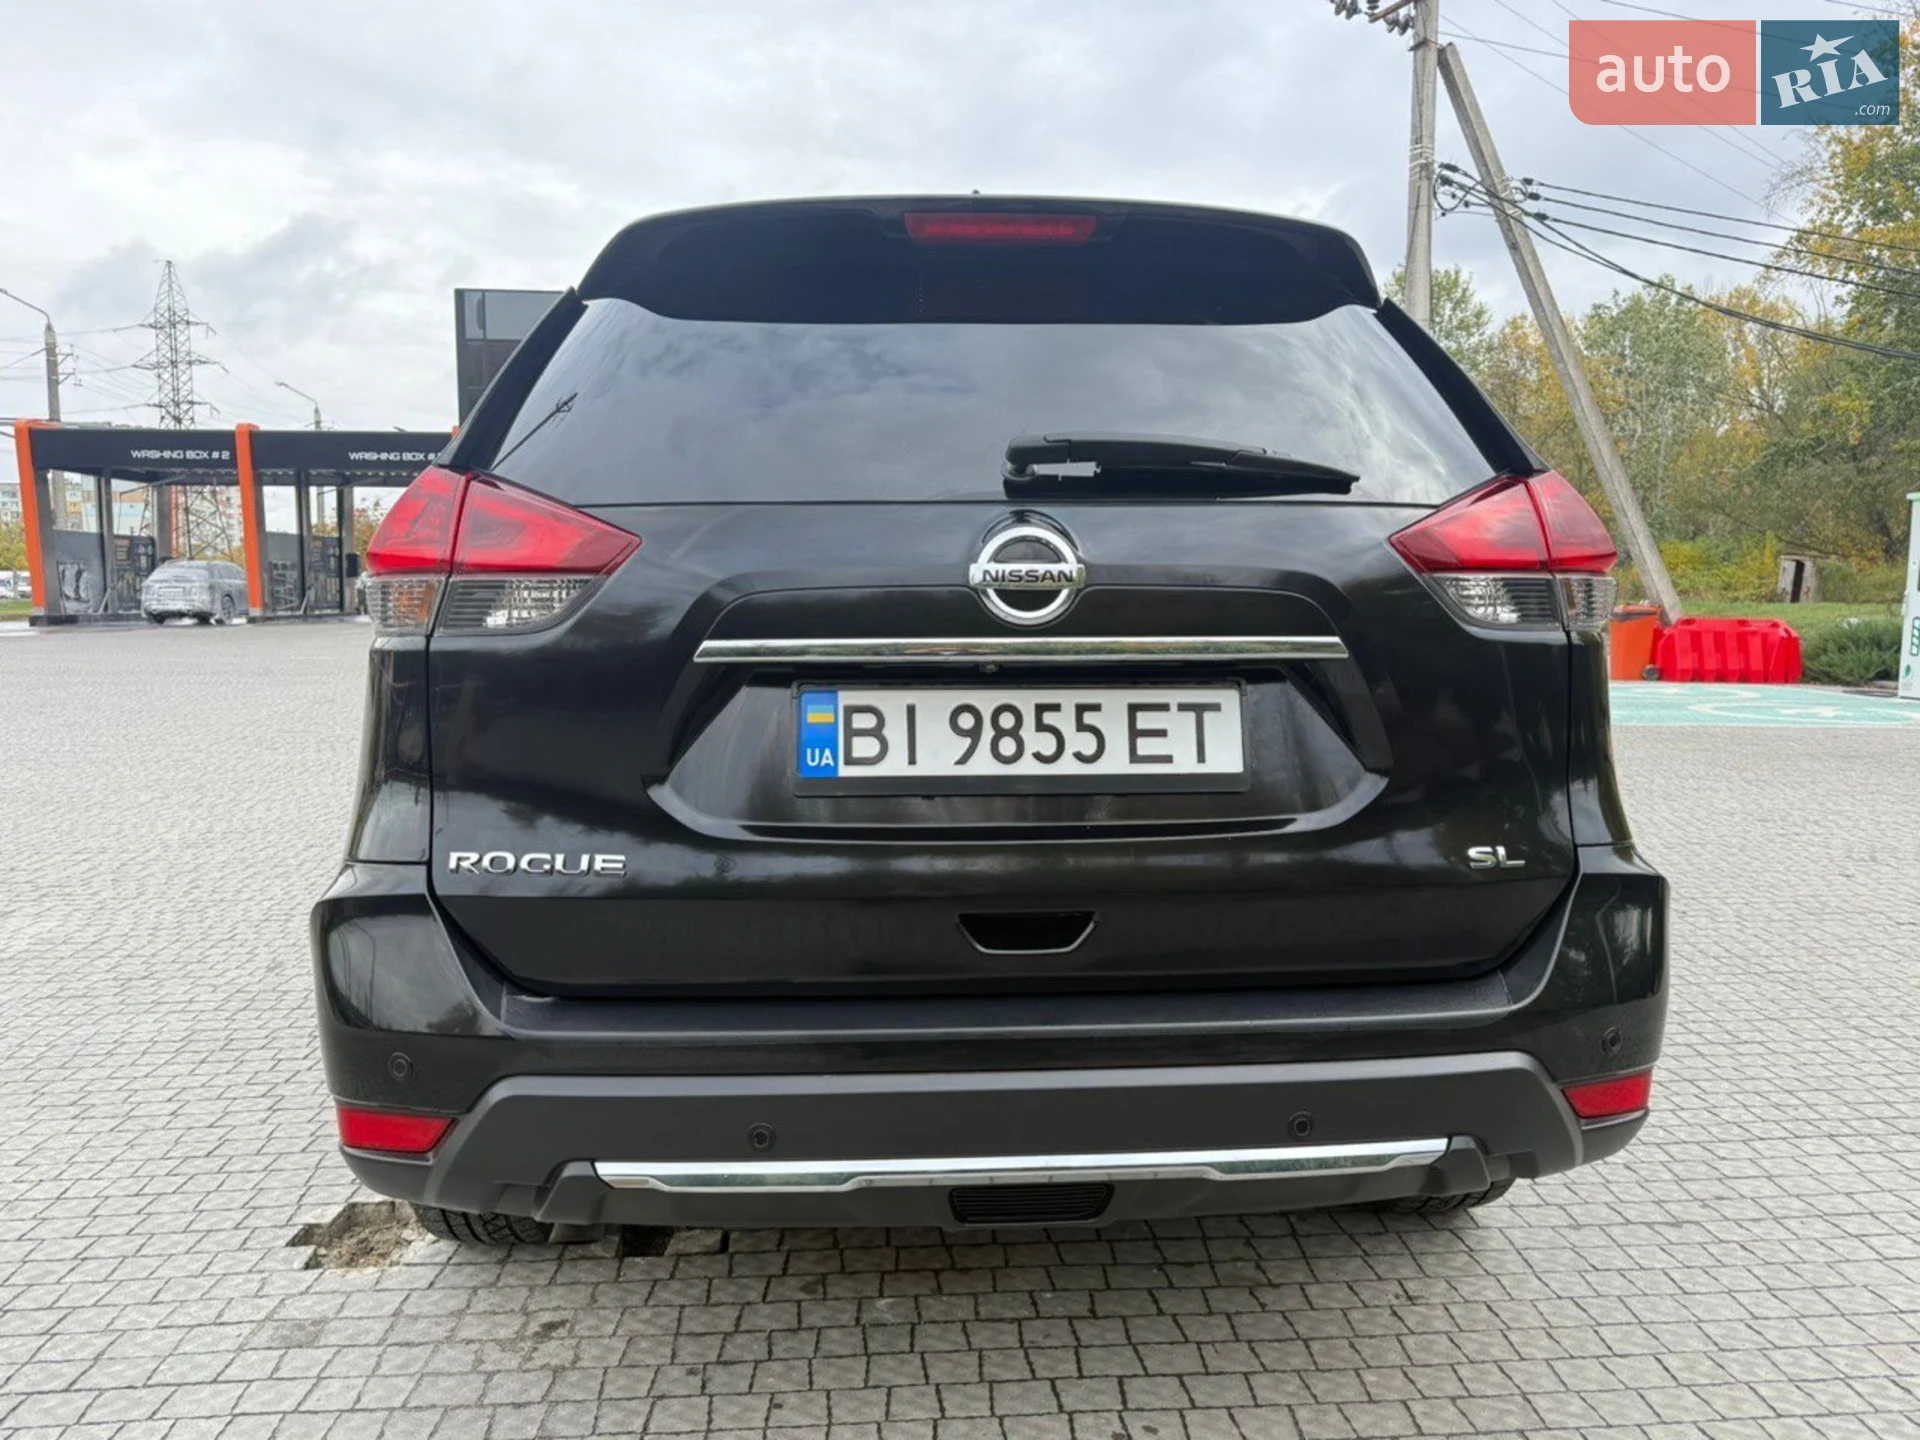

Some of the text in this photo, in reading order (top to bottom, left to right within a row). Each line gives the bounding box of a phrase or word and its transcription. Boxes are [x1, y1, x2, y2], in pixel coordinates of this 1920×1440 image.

[131, 449, 184, 459] WASHING
[185, 450, 209, 460] BOX
[348, 451, 400, 461] WASHING
[402, 452, 425, 461] BOX
[982, 569, 1074, 583] NISSAN
[842, 702, 1222, 766] BI 9855 ET
[806, 748, 835, 767] UA
[449, 851, 627, 877] ROGUE
[1467, 845, 1526, 869] SL
